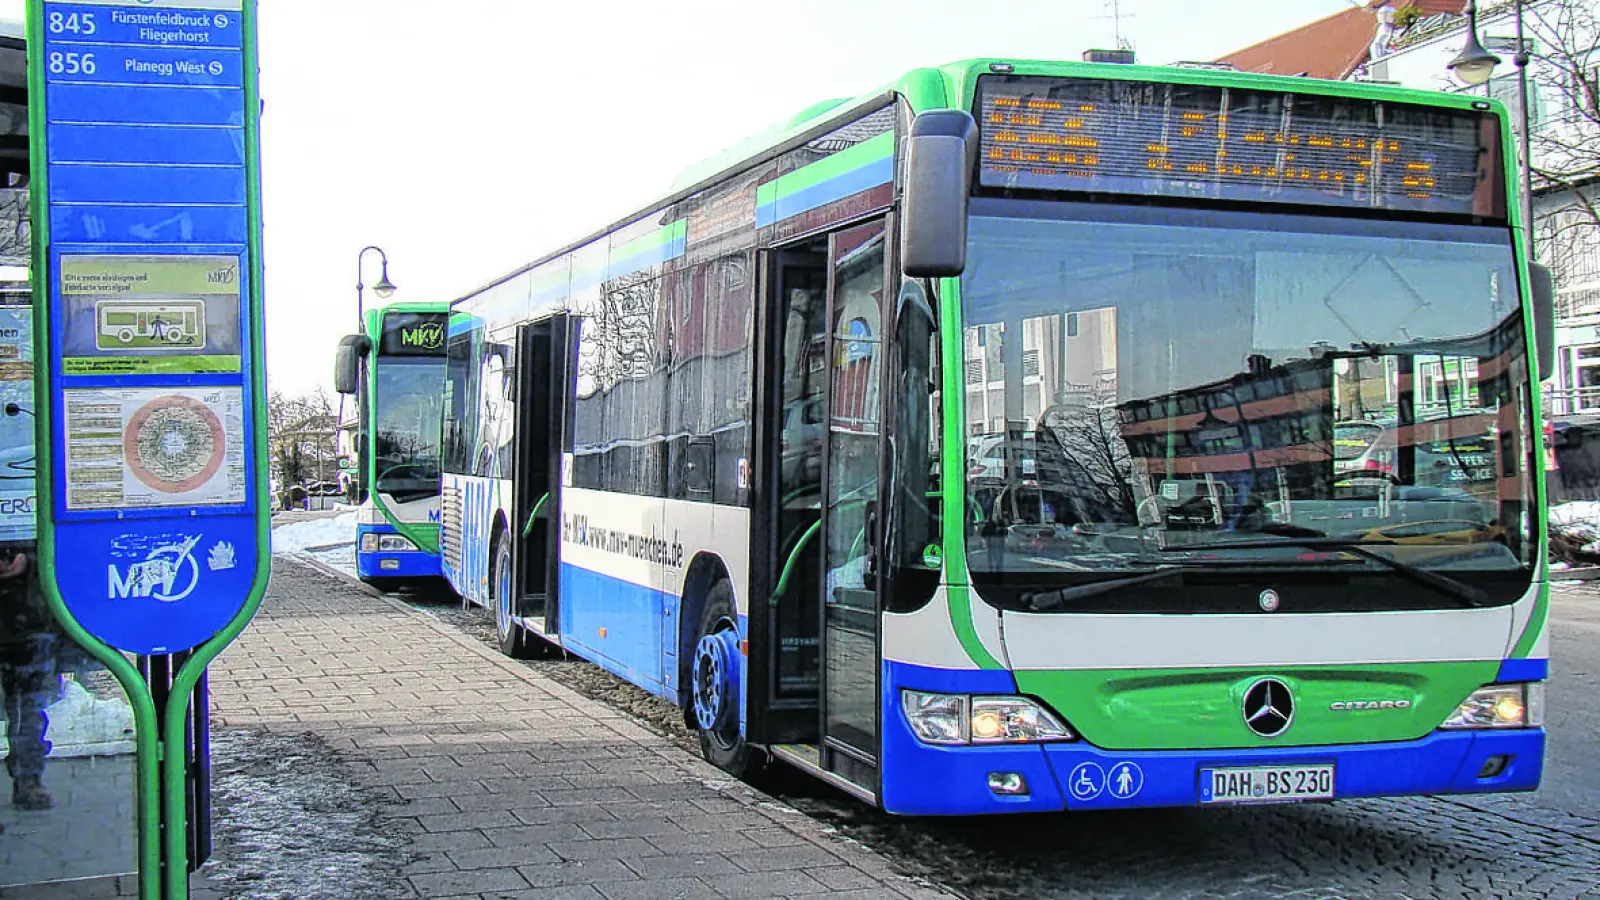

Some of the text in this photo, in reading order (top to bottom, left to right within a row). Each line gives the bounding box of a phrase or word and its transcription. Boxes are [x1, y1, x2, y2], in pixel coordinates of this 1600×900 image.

[49, 12, 96, 34] 845
[112, 11, 211, 27] Fürstenfeldbruck
[140, 28, 209, 44] Fliegerhorst
[49, 52, 96, 74] 856
[125, 59, 173, 76] Planegg
[175, 61, 206, 74] West
[1329, 699, 1411, 710] CITARO
[1214, 772, 1252, 798] DAH
